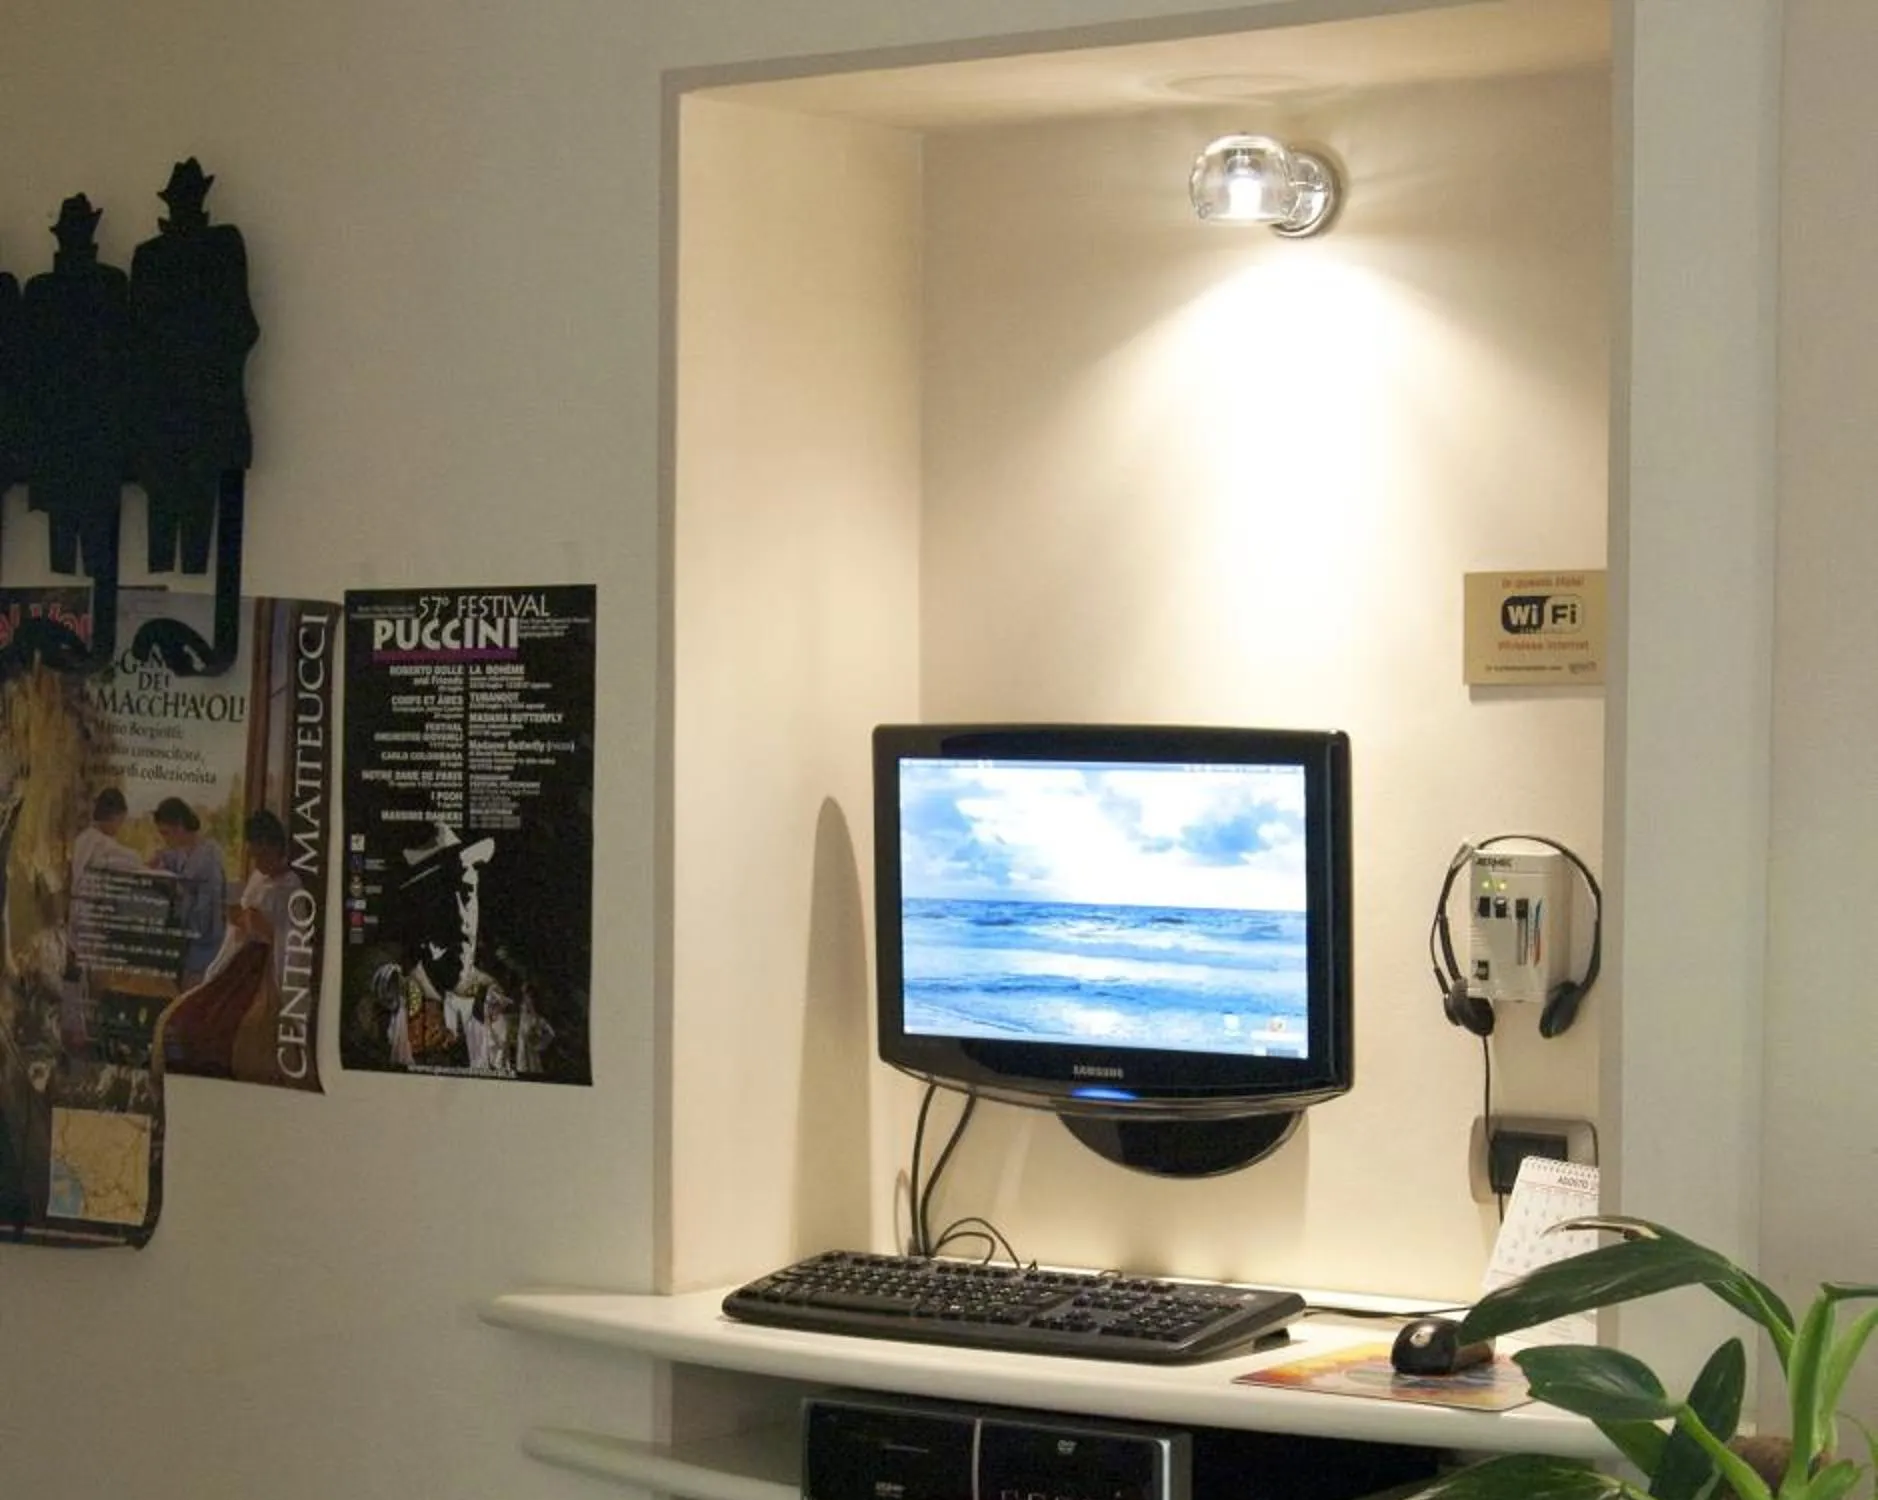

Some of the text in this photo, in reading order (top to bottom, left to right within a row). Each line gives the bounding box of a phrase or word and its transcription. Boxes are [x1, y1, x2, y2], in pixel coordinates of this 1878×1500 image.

[457, 594, 550, 619] FESTIVAL
[373, 616, 520, 650] PUCCINI
[138, 671, 170, 691] DEI
[277, 614, 329, 1079] CENTRO MATTEUCCI
